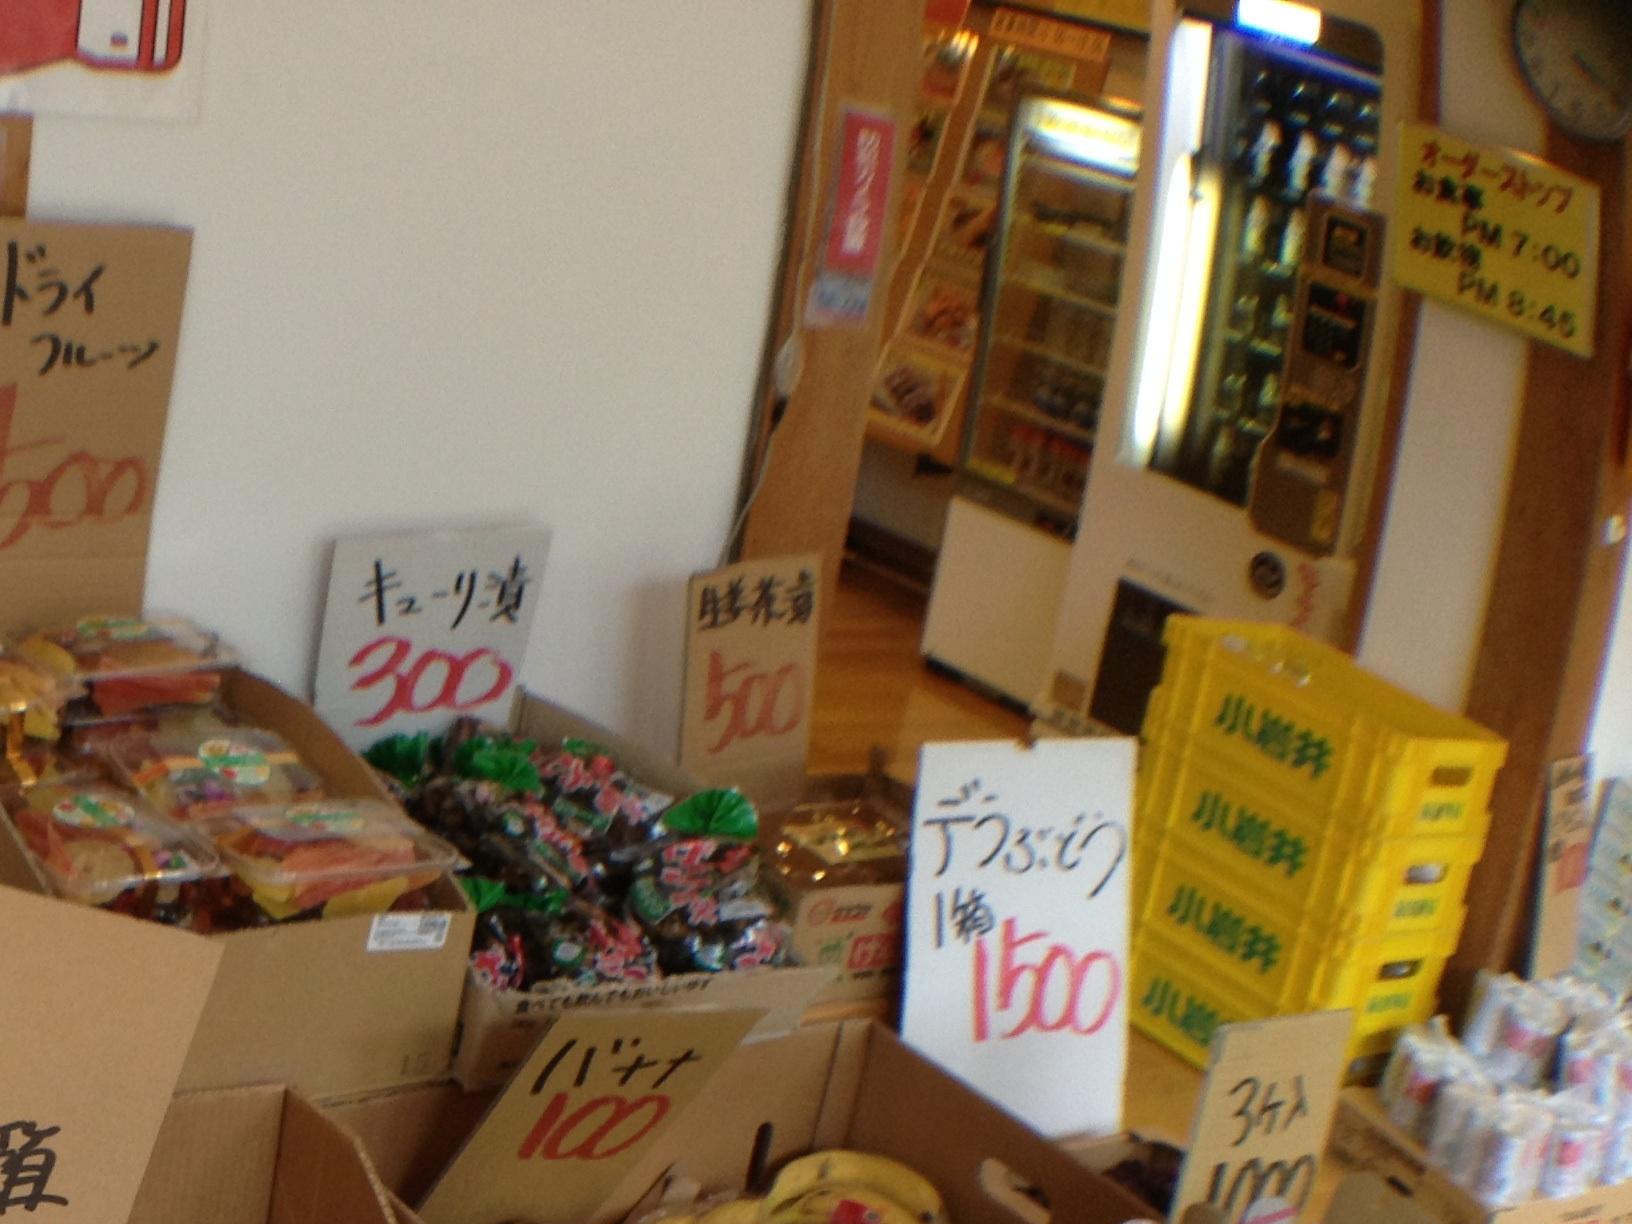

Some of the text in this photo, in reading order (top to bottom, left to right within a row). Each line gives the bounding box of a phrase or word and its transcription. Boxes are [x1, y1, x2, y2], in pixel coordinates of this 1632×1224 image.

[0, 240, 107, 327] ドライ
[1512, 229, 1581, 280] 7:00
[27, 331, 161, 376] フルーツ
[347, 634, 513, 728] 300
[703, 650, 805, 756] 500
[1214, 693, 1335, 781] 小岩井
[1191, 790, 1309, 880] 小岩井
[1166, 884, 1284, 974] 小岩井
[972, 917, 1121, 1043] 1500
[530, 1037, 703, 1096] バナナ
[517, 1091, 671, 1161] 100
